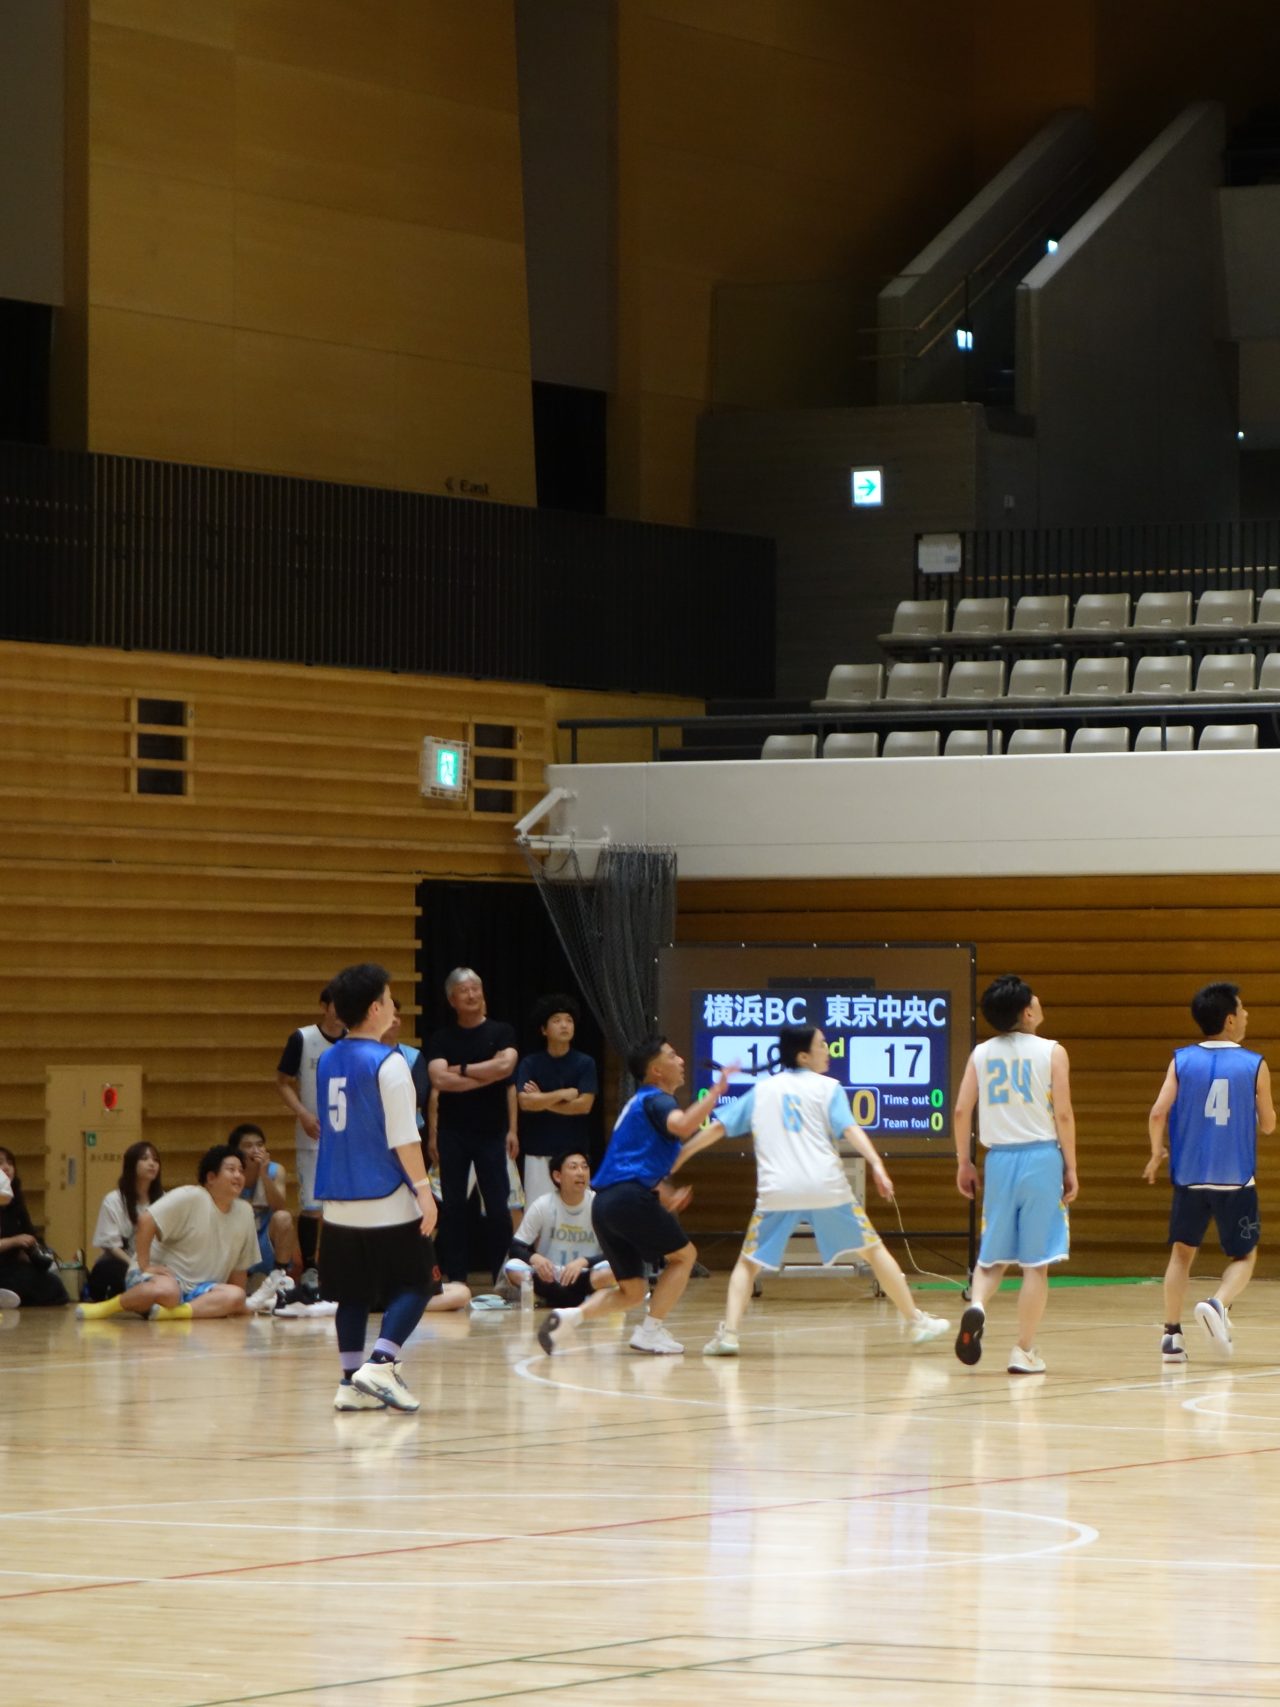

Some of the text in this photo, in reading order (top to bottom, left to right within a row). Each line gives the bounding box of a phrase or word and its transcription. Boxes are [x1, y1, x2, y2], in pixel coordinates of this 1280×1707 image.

[703, 994, 807, 1027] 横浜BC
[825, 994, 946, 1028] 東京中央C
[884, 1043, 924, 1078] 17
[883, 1088, 944, 1108] Time out 0
[986, 1058, 1033, 1105] 24
[328, 1077, 347, 1132] 5
[1204, 1078, 1231, 1126] 4
[883, 1112, 944, 1131] Team foul 0
